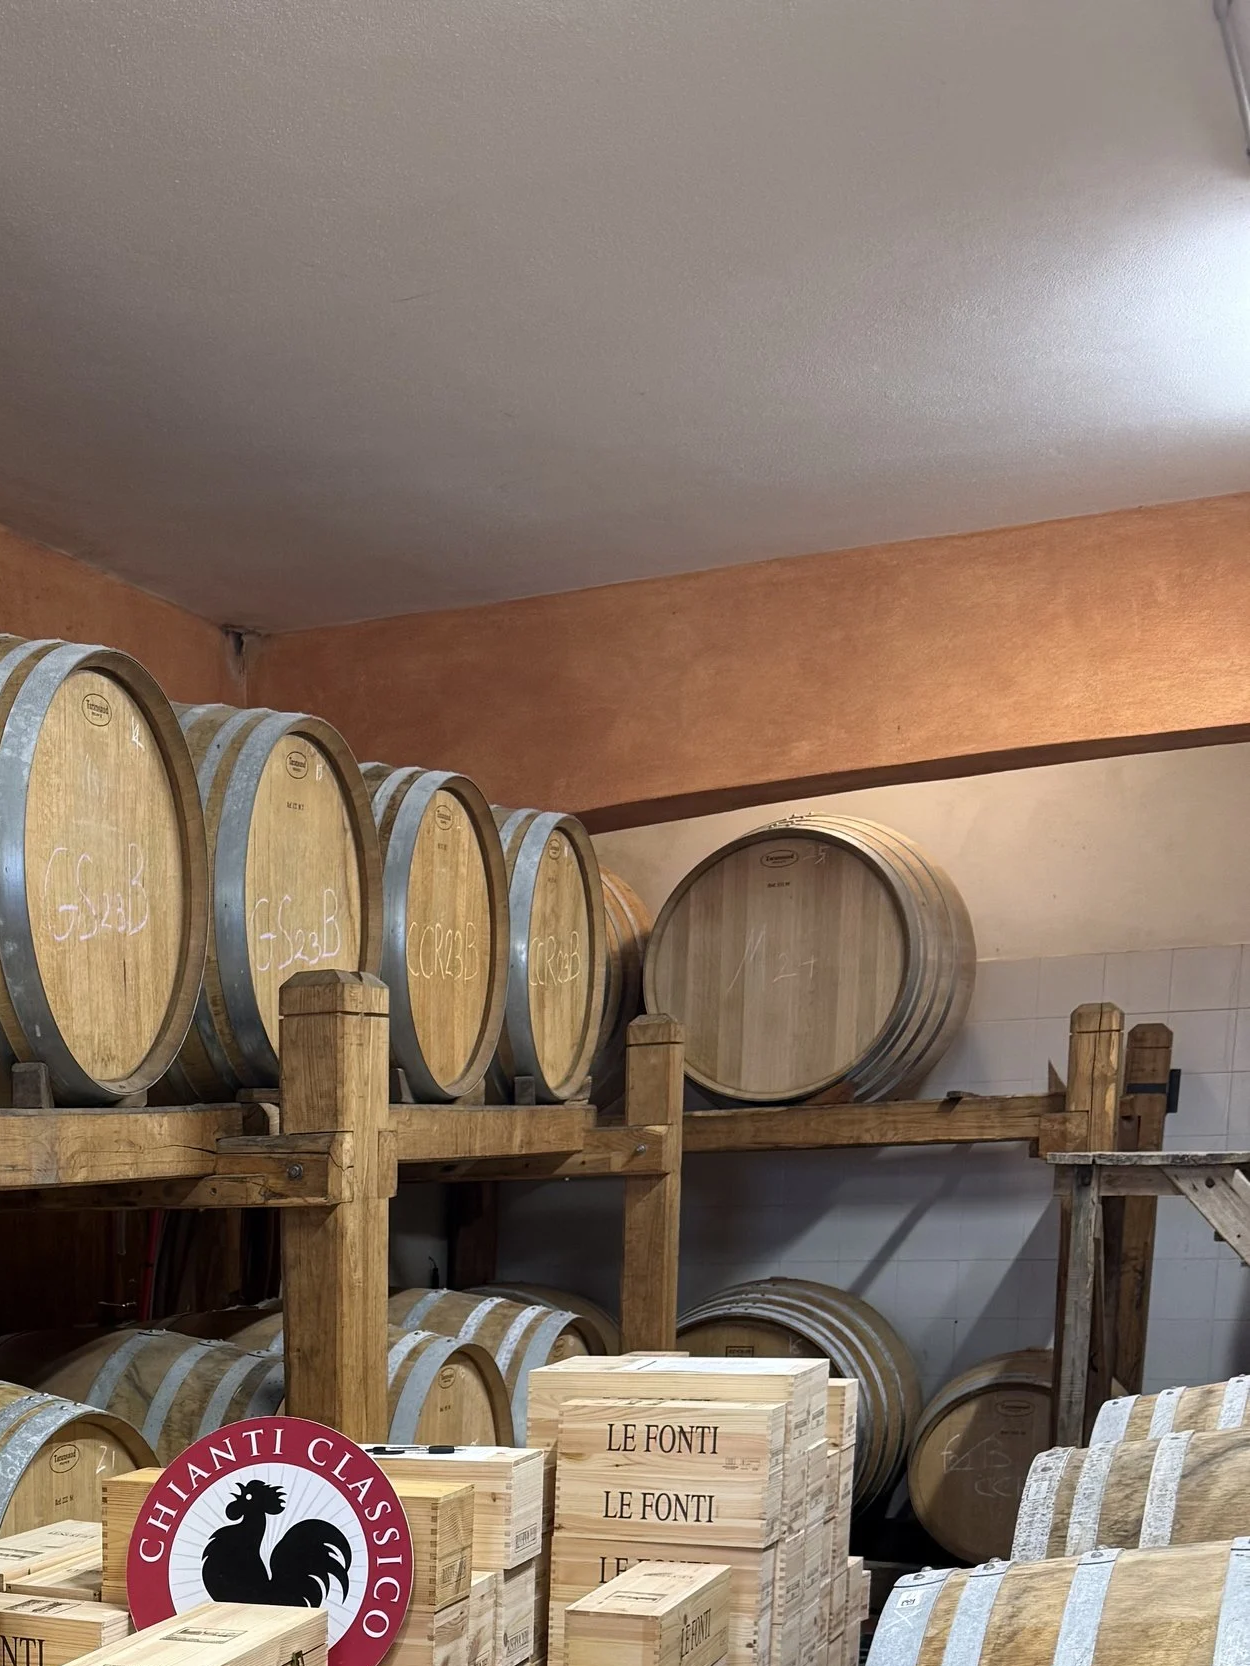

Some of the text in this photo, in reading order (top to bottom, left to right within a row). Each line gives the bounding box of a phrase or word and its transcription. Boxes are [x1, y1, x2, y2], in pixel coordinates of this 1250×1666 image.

[250, 888, 341, 971] GS23B
[406, 922, 480, 982] CCR23B
[527, 931, 581, 986] CCR23B
[606, 1423, 719, 1455] LE FONTI
[139, 1428, 402, 1638] CHIANTI CLASSICO
[602, 1491, 715, 1523] LE FONTI
[690, 1608, 712, 1650] FONTI
